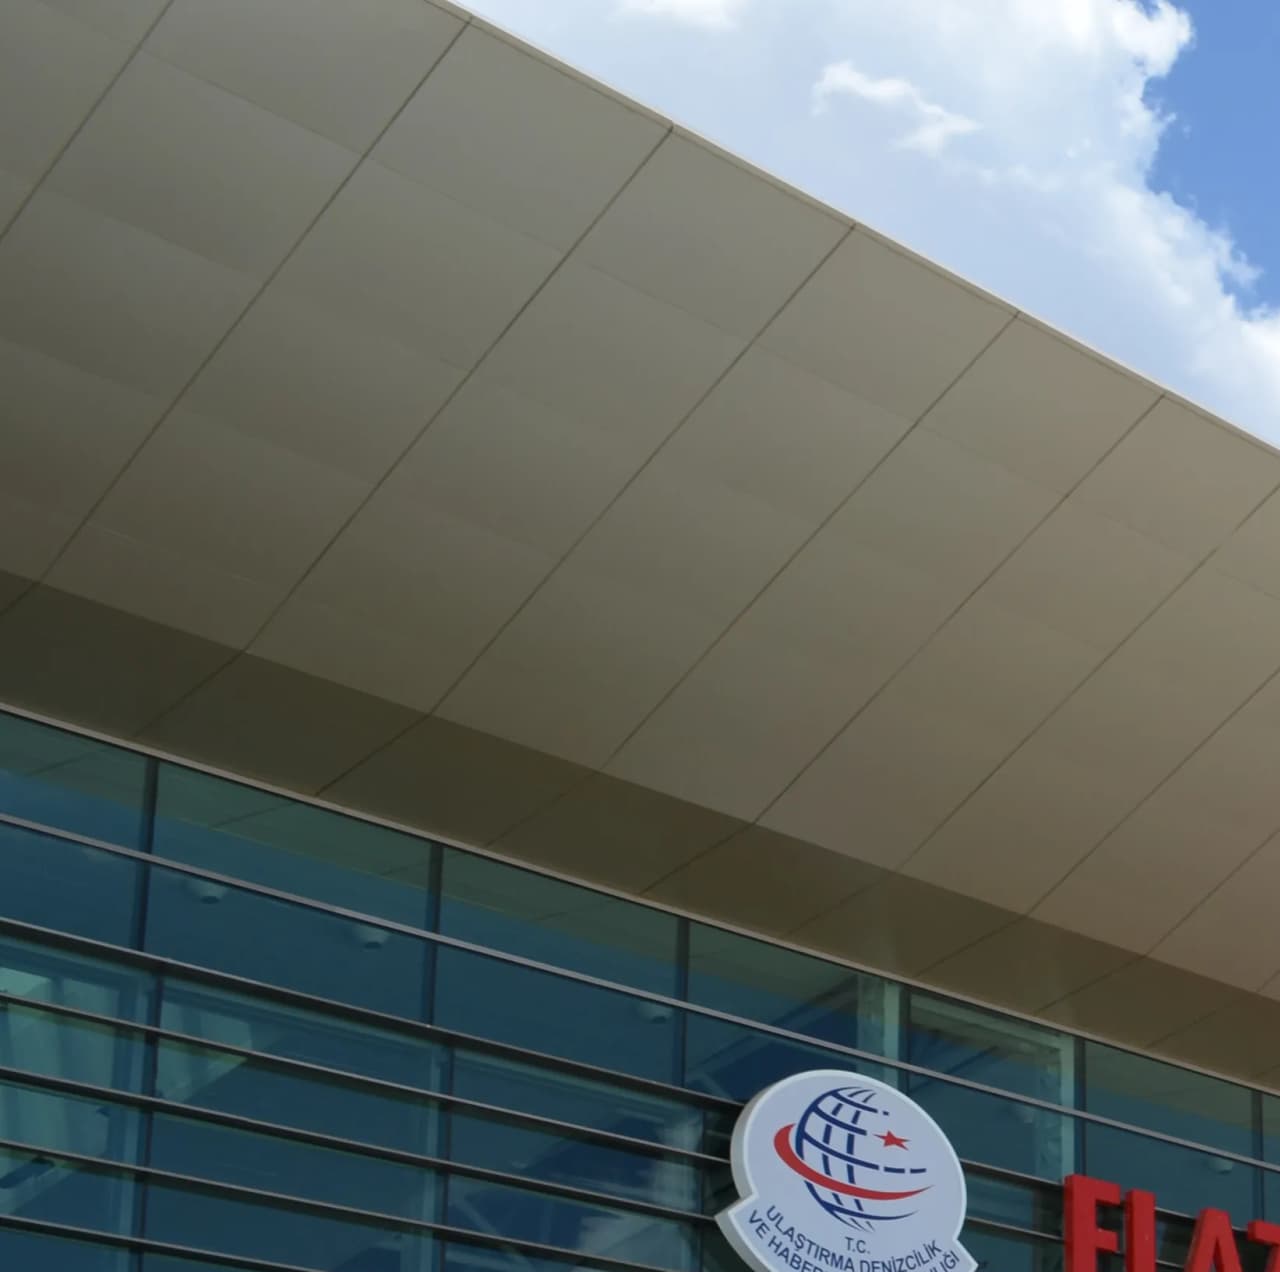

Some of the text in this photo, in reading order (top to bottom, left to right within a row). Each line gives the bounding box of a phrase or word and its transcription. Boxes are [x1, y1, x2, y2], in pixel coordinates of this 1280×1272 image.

[748, 1210, 770, 1239] VE
[766, 1205, 855, 1272] ULAŞTIRMA
[845, 1236, 870, 1255] T.C.
